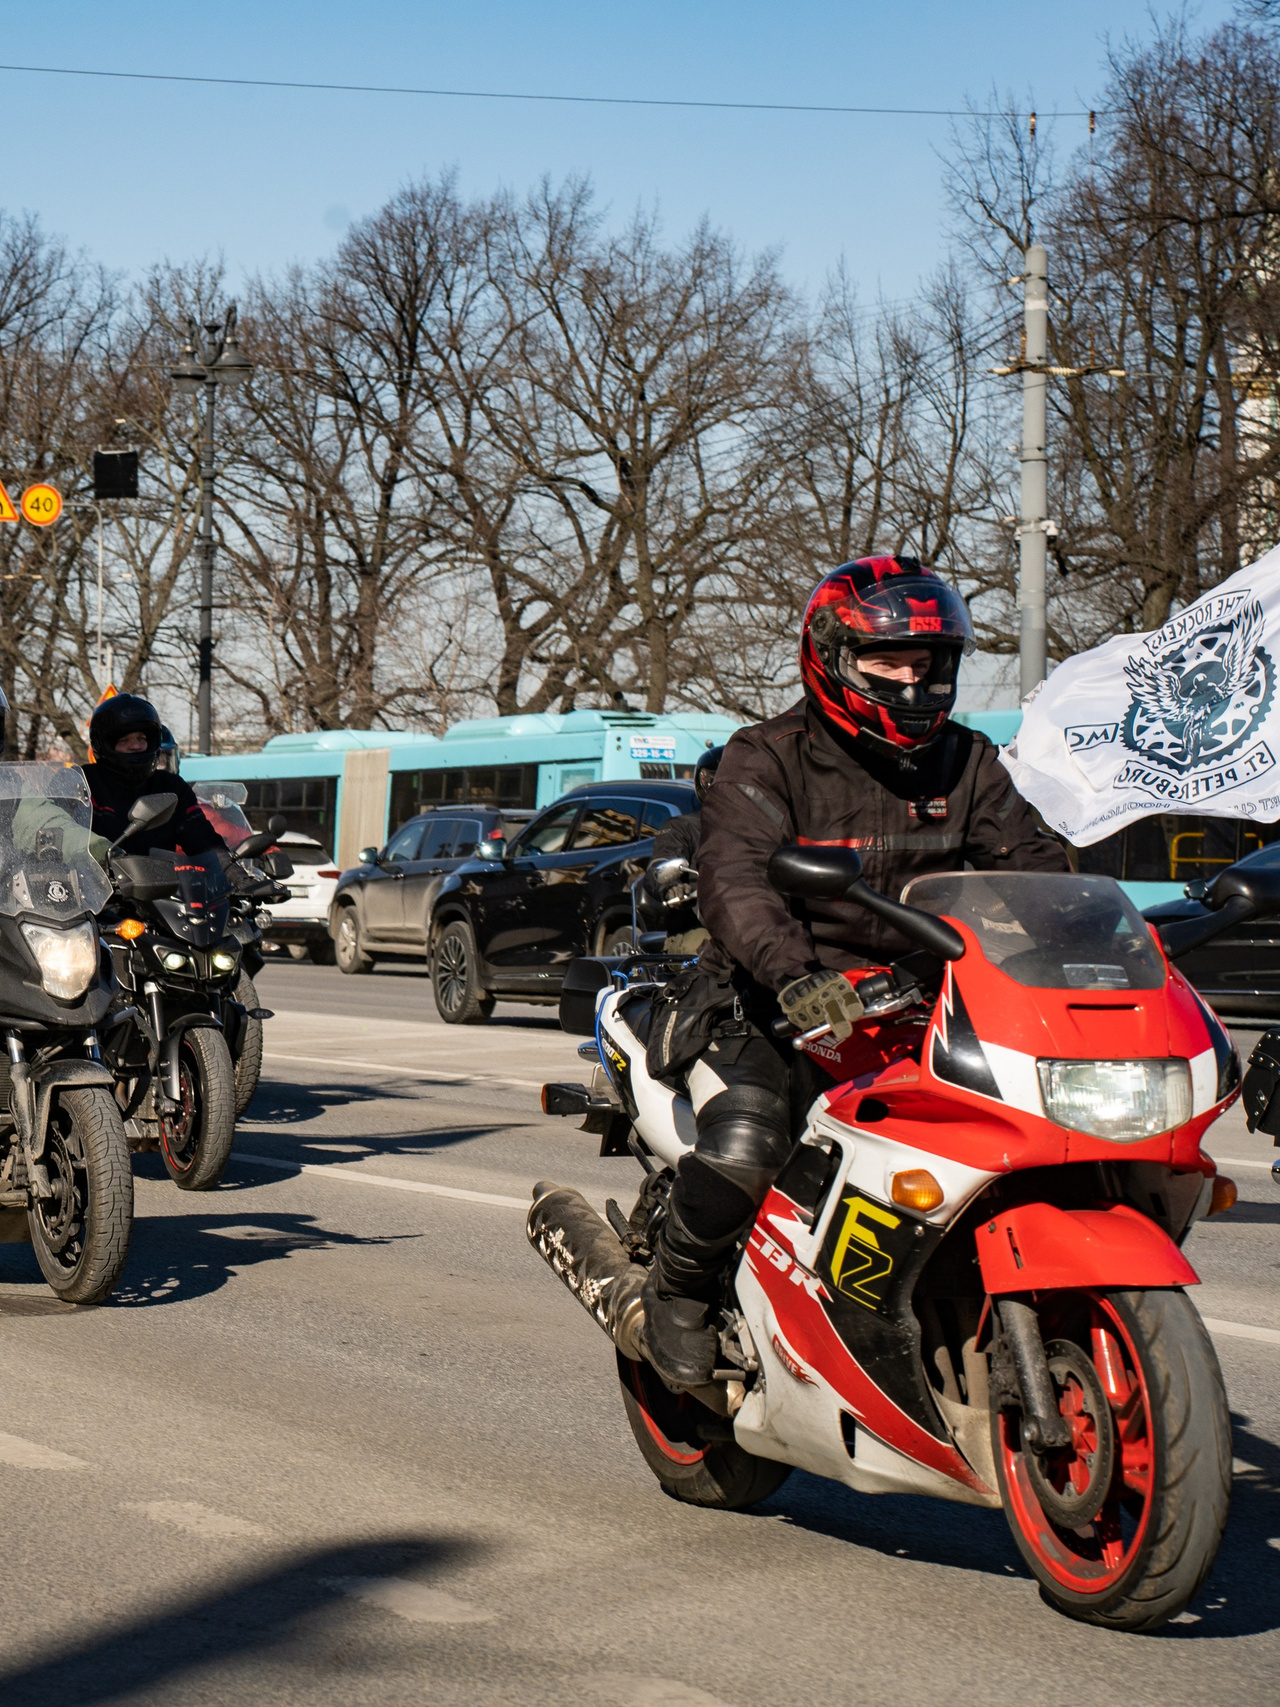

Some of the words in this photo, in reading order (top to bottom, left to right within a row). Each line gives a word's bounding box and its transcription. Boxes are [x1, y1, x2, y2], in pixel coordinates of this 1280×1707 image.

[30, 497, 53, 512] 40
[804, 1041, 842, 1063] HONDA
[774, 1339, 799, 1376] DRIVE
